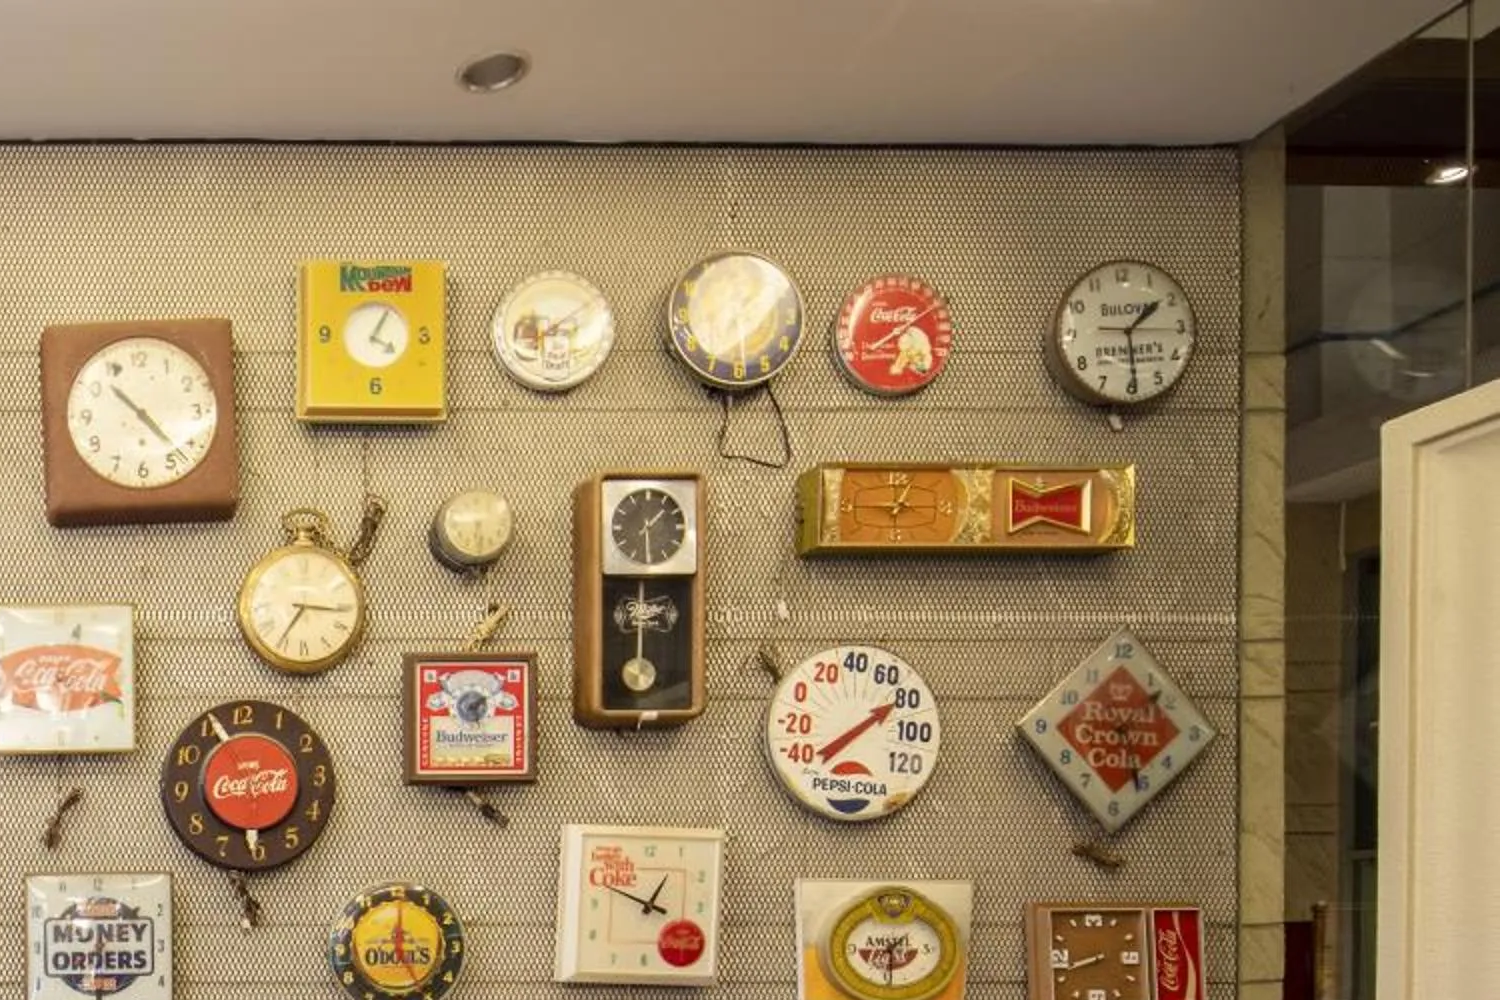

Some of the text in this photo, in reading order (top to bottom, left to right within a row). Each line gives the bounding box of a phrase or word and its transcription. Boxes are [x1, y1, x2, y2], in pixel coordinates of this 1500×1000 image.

[1089, 278, 1100, 292] 11
[1115, 269, 1129, 283] 12
[1147, 274, 1152, 287] 1
[1101, 303, 1151, 316] BULOV
[319, 325, 331, 343] 9
[418, 326, 431, 344] 3
[1077, 355, 1087, 370] 8
[369, 377, 383, 394] 6
[1099, 375, 1108, 389] 7
[1154, 372, 1163, 385] 5
[843, 652, 868, 672] 40
[814, 662, 839, 683] 20
[874, 664, 899, 685] 60
[794, 682, 807, 702] 0
[895, 688, 920, 708] 80
[232, 705, 253, 725] 12
[276, 711, 283, 730] 1
[897, 720, 932, 742] 100
[300, 734, 313, 752] 2
[177, 745, 200, 766] 10
[889, 752, 922, 774] 120
[314, 765, 326, 786] 3
[175, 780, 188, 801] 9
[305, 800, 320, 821] 4
[189, 813, 203, 835] 8
[216, 835, 229, 857] 7
[285, 827, 299, 849] 5
[53, 923, 148, 943] MONEY
